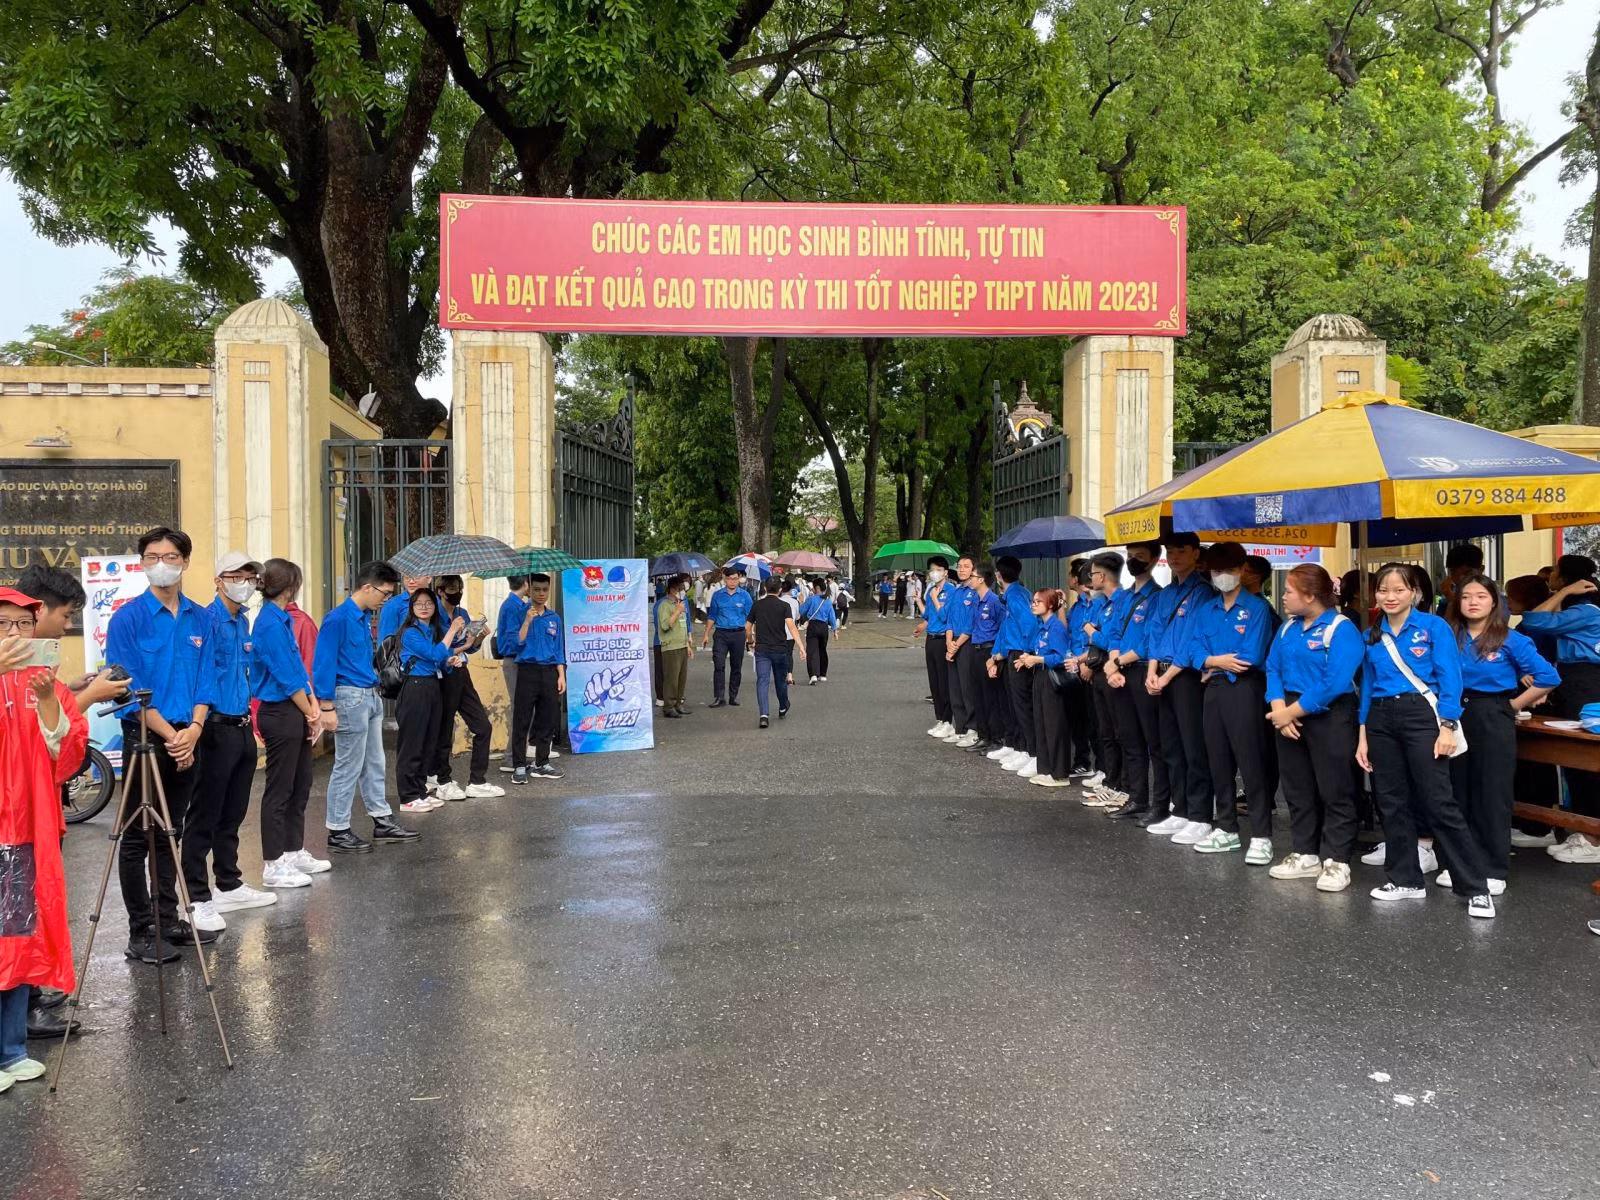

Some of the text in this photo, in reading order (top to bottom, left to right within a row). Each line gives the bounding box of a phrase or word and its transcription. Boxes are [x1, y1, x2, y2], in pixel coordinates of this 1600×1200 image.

[592, 216, 1044, 265] CHÚC CÁC EM HỌC SINH BÌNH TĨNH, TỰ TIN
[471, 266, 1158, 317] VÀ ĐẠT KẾT QUẢ CAO TRONG KỲ THI TỐT NGHIỆP THPT NĂM 2023!
[17, 482, 41, 493] DỤC
[43, 480, 59, 491] VÀ
[60, 480, 84, 491] ĐÀO
[86, 482, 108, 493] TẠO
[110, 480, 126, 491] HÀ
[127, 481, 147, 493] NỘI
[1437, 487, 1566, 505] 0379 884 488
[13, 525, 56, 535] TRUNG
[59, 525, 86, 538] HỌC
[89, 520, 116, 535] PHỔ
[118, 523, 162, 535] THÔN
[1274, 548, 1286, 556] THI
[614, 623, 641, 632] TNTN
[597, 651, 615, 661] THI
[616, 649, 644, 661] 2023
[606, 710, 639, 728] 2023
